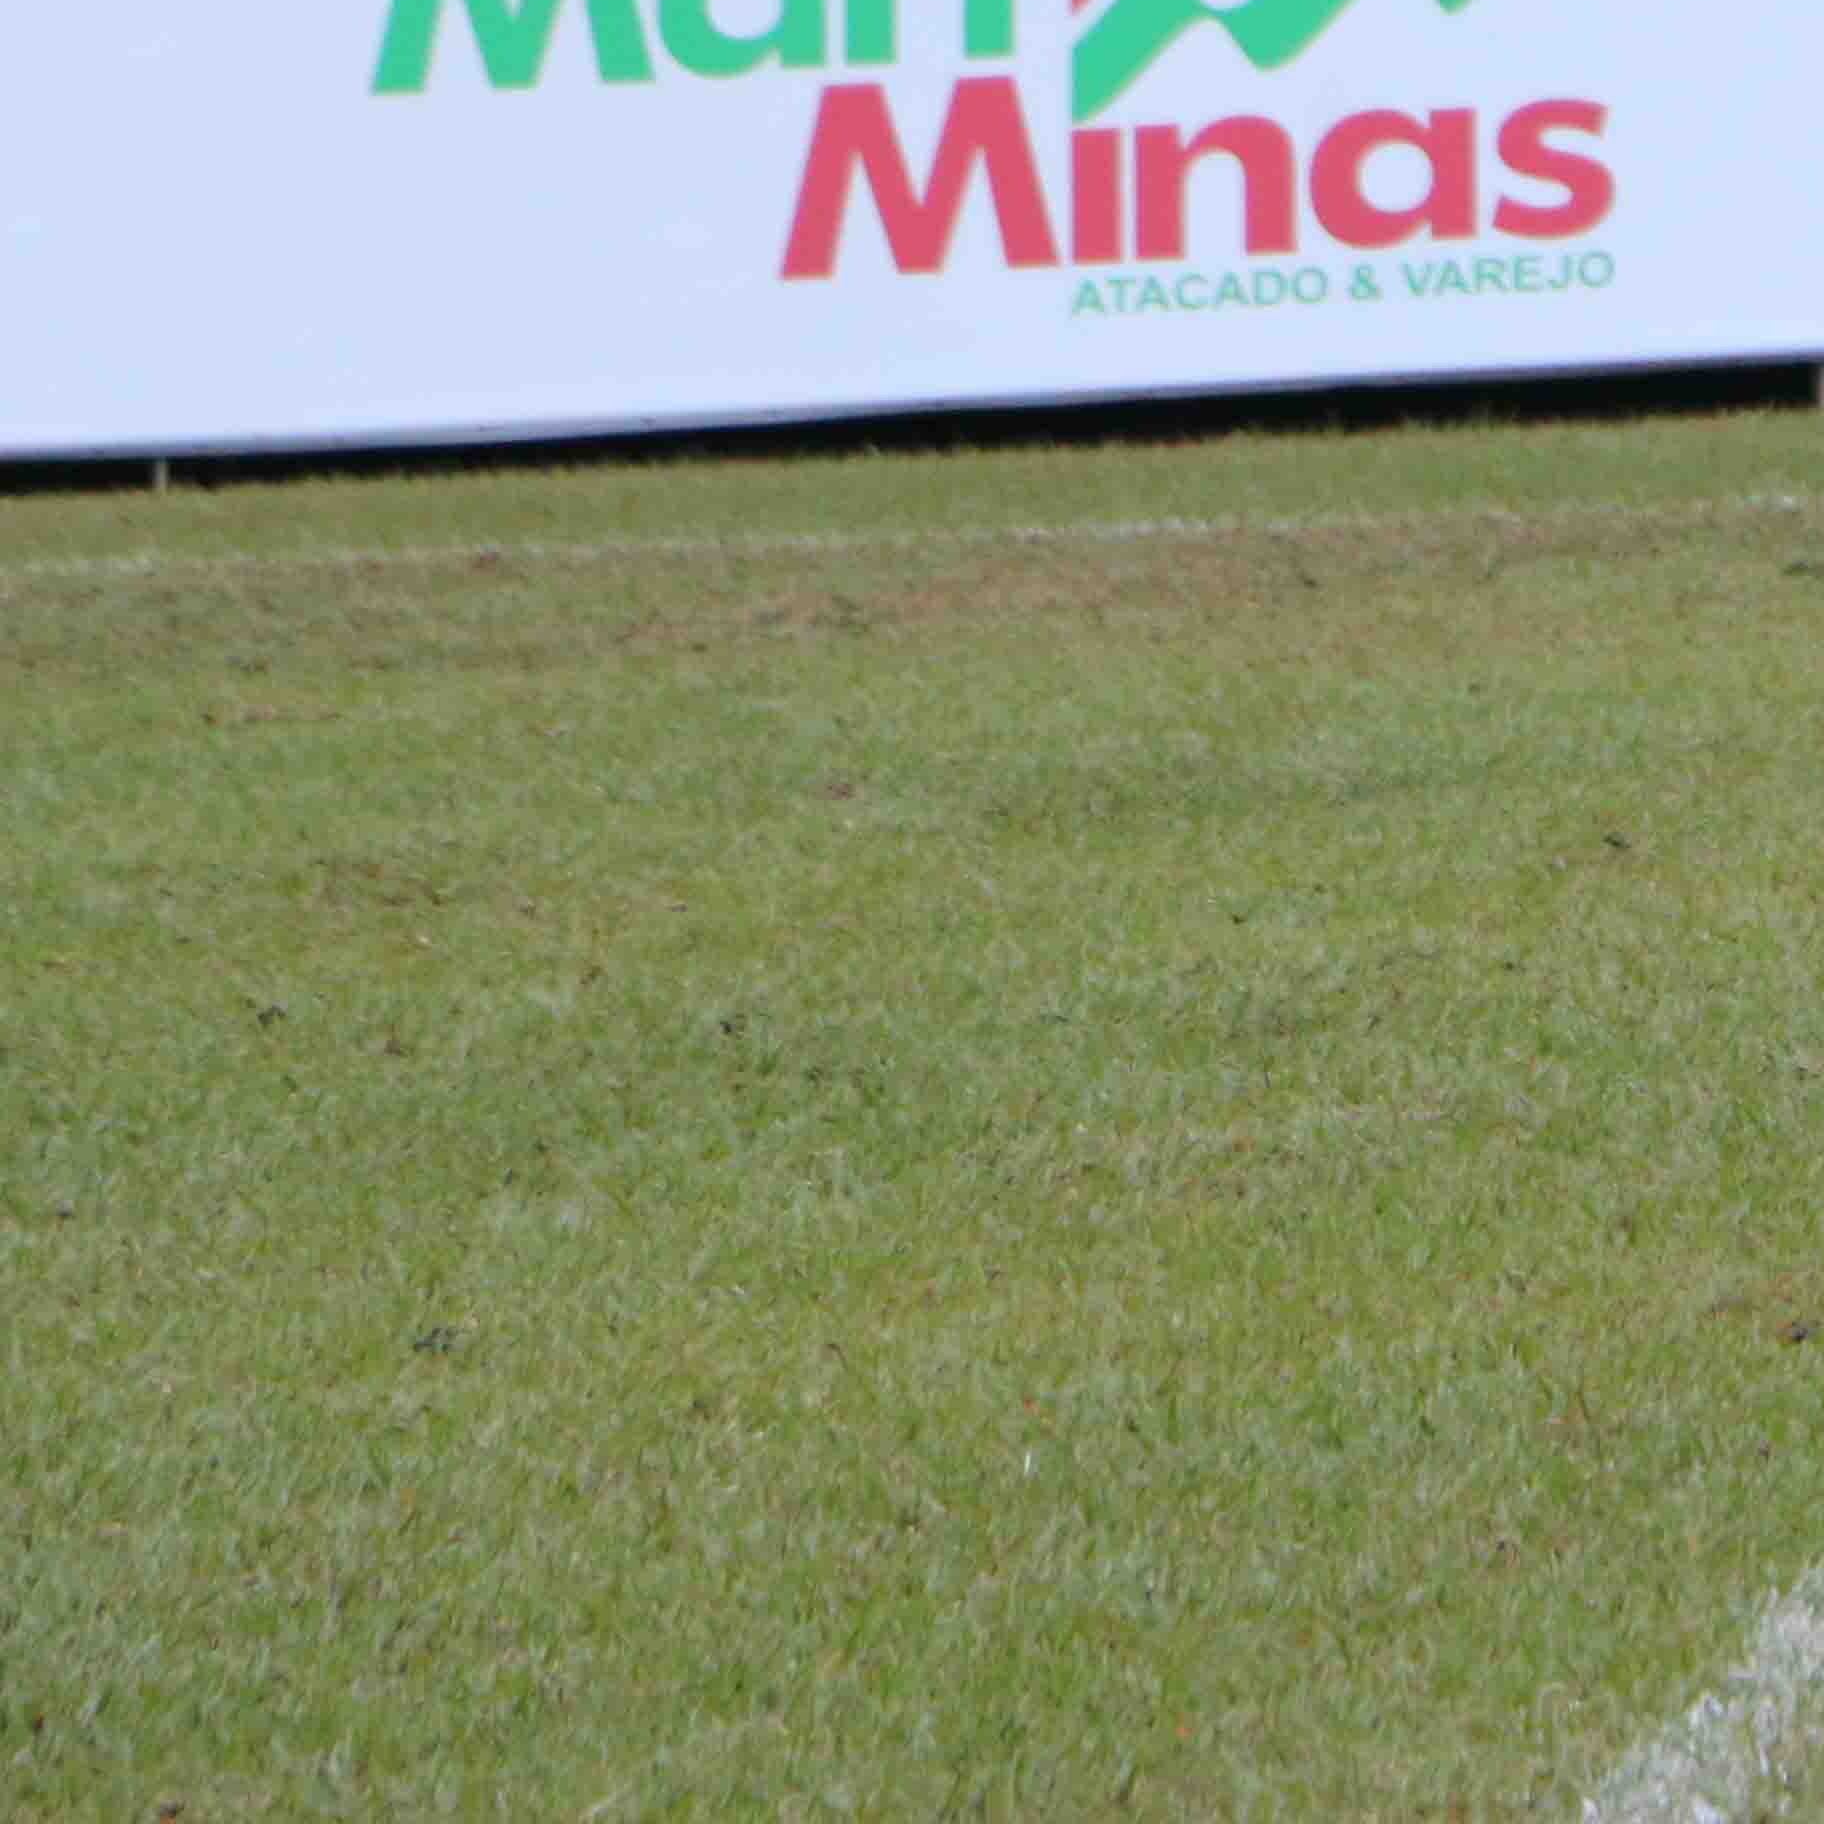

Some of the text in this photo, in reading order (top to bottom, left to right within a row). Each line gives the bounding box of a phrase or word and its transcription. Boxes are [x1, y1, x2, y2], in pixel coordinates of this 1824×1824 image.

[780, 76, 1615, 281] Minas
[1070, 250, 1616, 317] ATACADO & VAREJO
